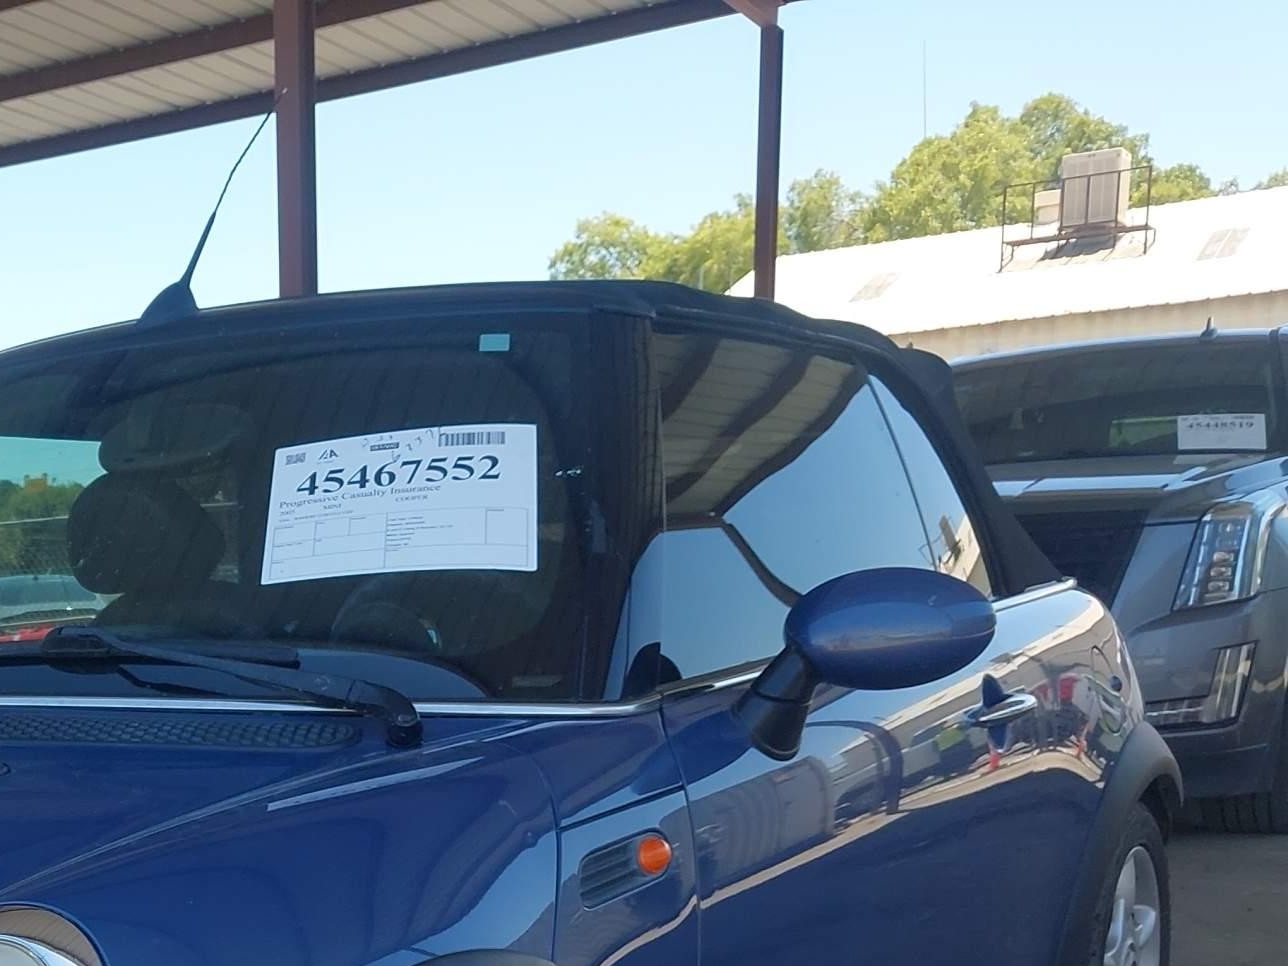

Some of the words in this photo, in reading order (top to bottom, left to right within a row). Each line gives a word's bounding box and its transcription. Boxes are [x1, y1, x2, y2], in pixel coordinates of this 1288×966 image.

[296, 454, 502, 497] 45467552
[279, 494, 339, 510] Progressive
[342, 487, 387, 501] Casualty
[391, 484, 442, 496] Insurance
